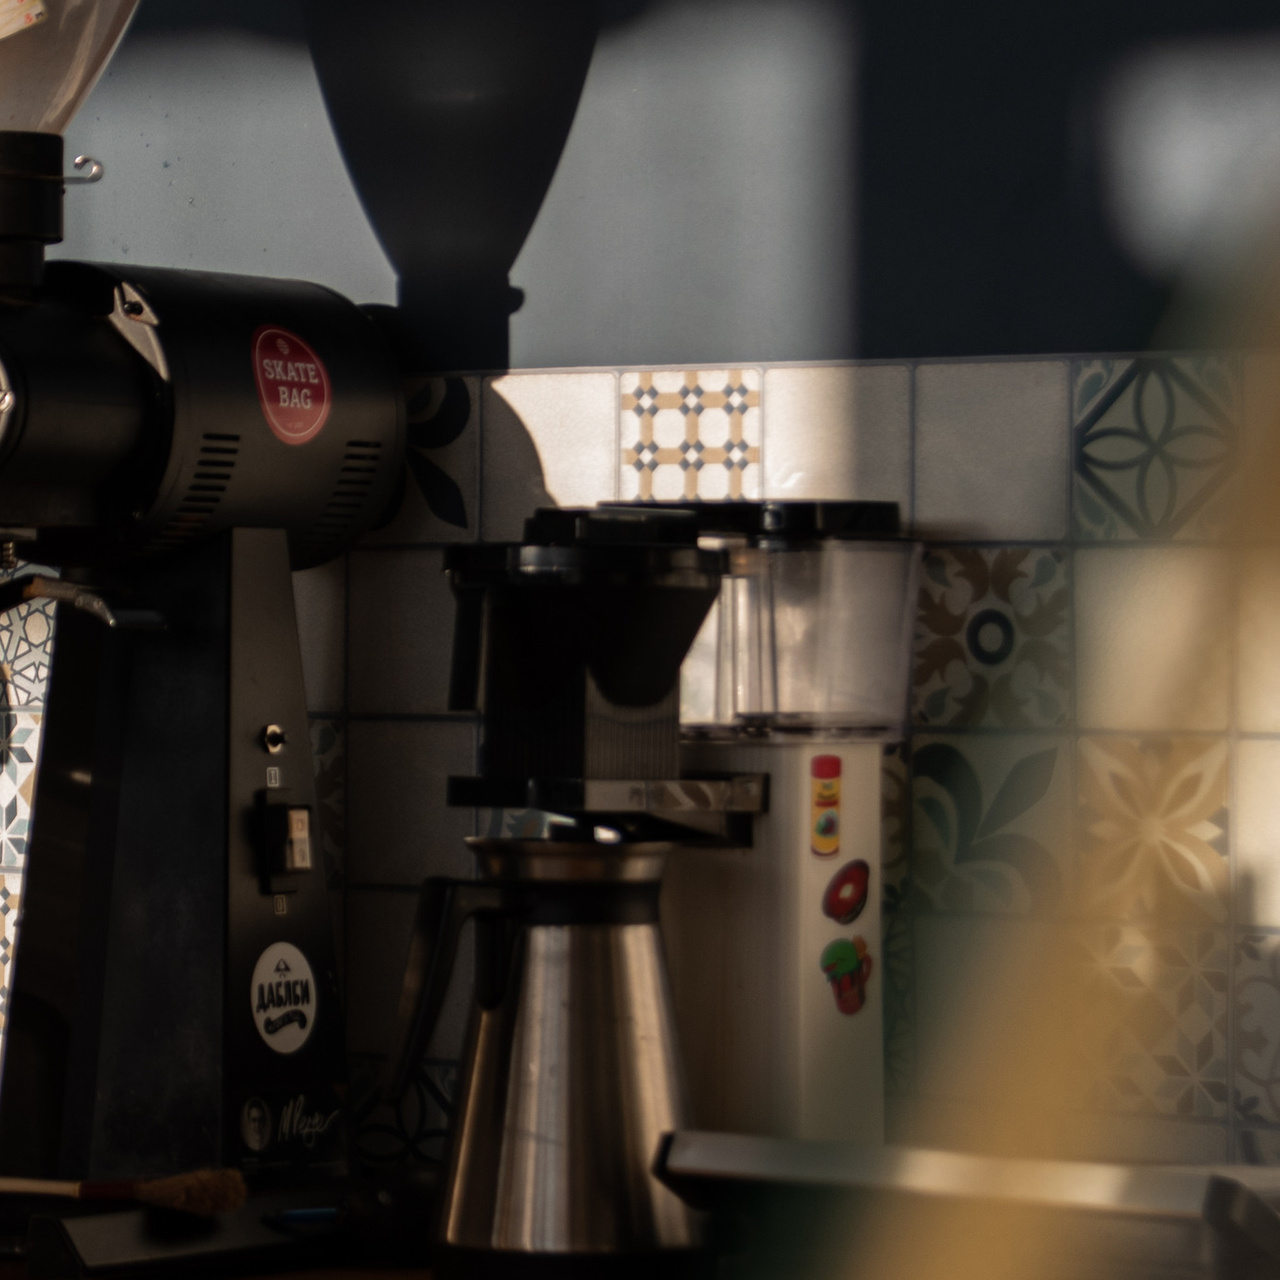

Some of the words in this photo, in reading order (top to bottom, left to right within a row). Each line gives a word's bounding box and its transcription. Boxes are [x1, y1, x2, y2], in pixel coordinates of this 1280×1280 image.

[263, 358, 319, 384] SKATE
[278, 386, 312, 409] BAG
[256, 978, 310, 1014] ДАБЛБИ
